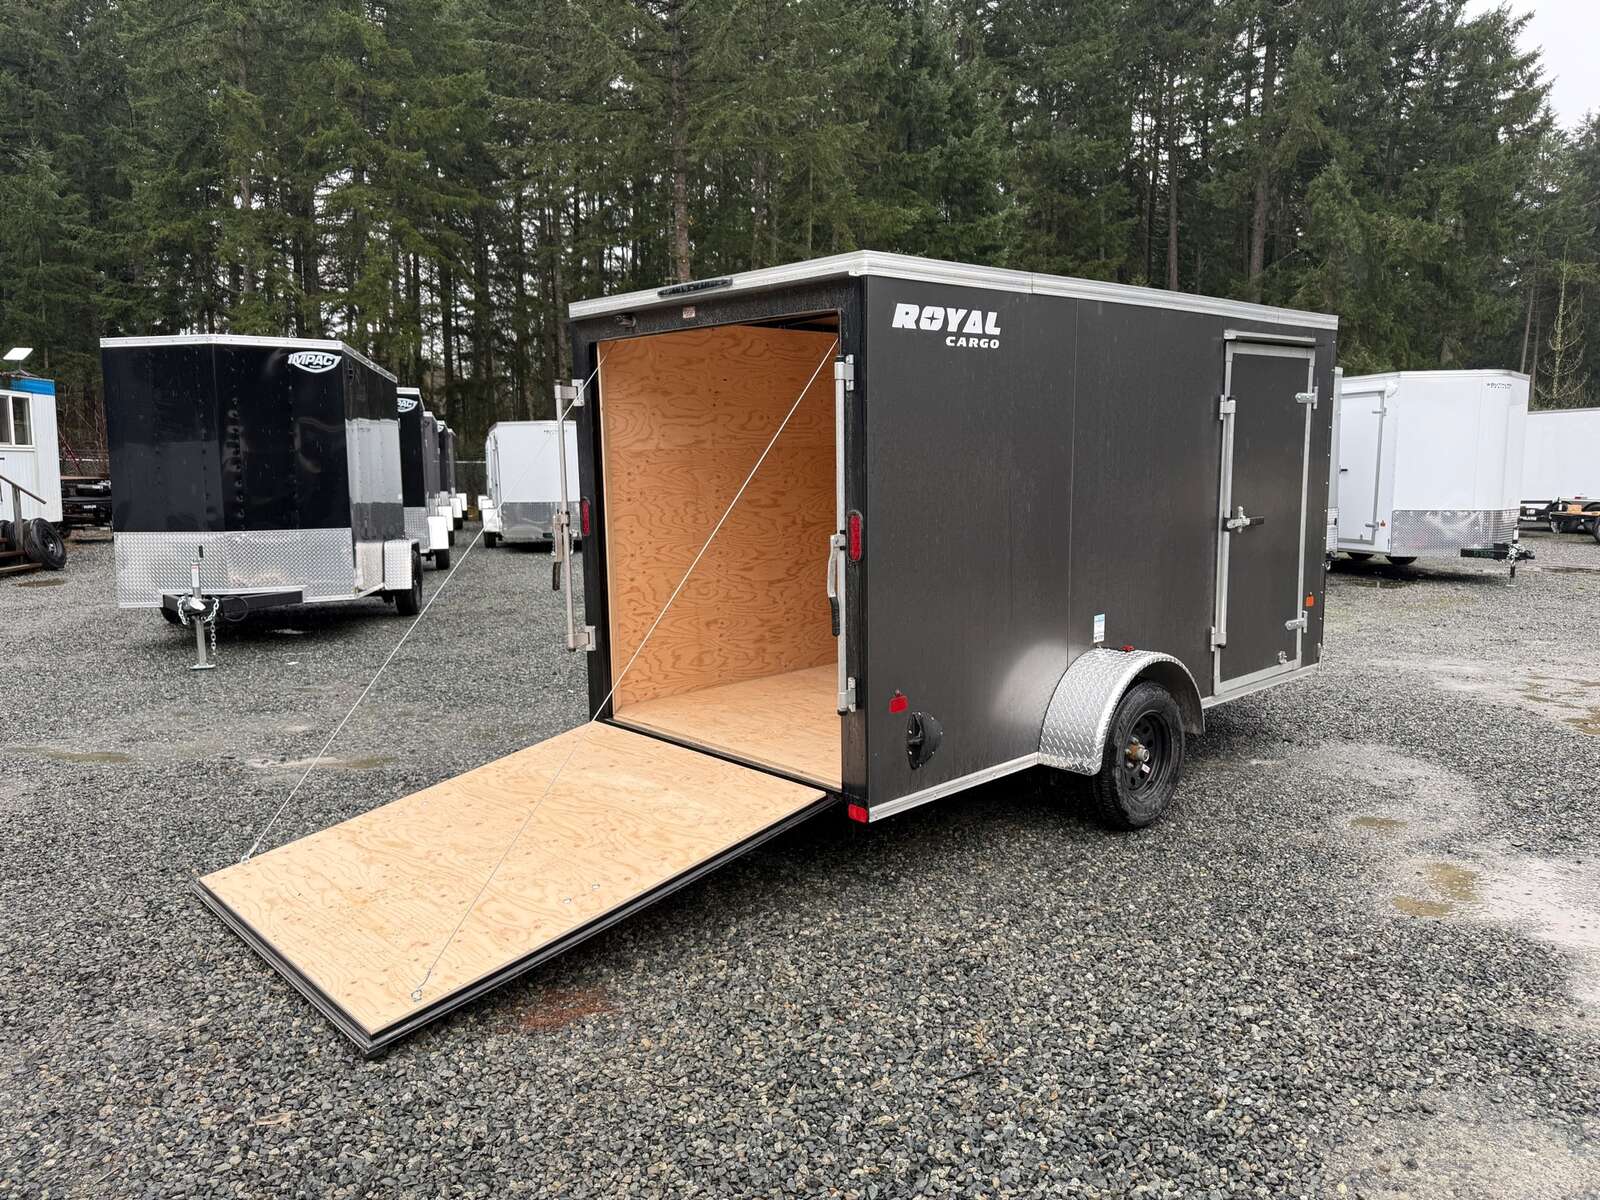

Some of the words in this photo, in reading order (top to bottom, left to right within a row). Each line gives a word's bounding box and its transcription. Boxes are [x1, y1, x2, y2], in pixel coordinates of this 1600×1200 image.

[892, 303, 1001, 335] ROYAL
[946, 336, 1000, 349] CARGO
[288, 353, 342, 366] IMPACT
